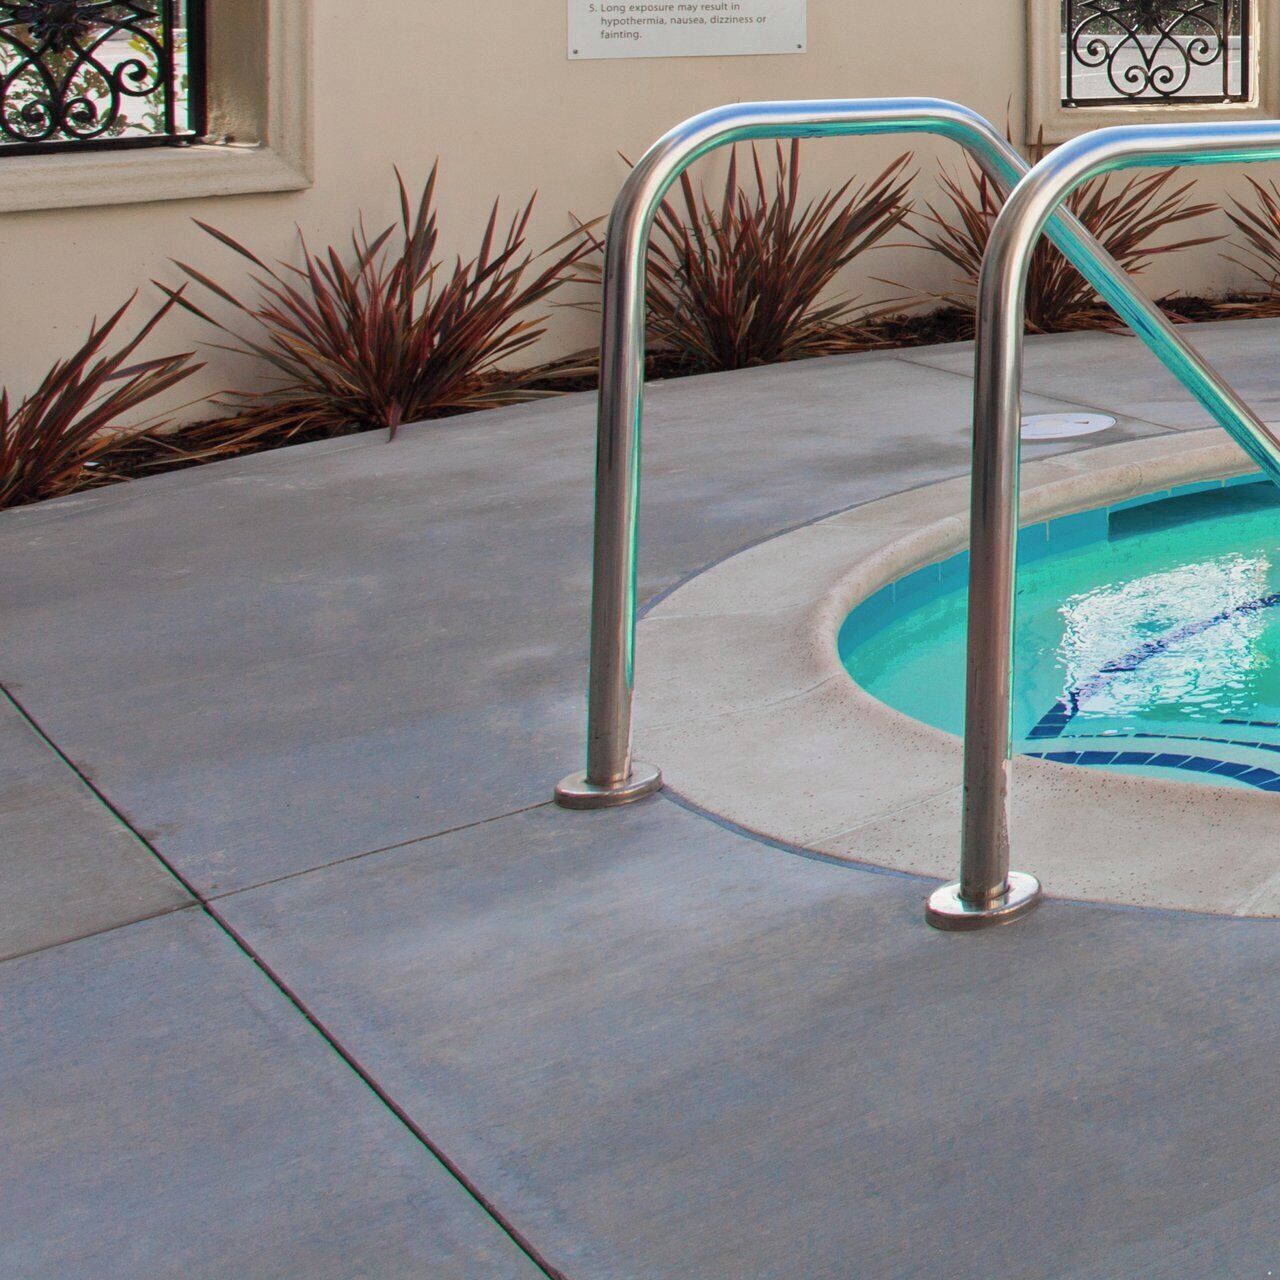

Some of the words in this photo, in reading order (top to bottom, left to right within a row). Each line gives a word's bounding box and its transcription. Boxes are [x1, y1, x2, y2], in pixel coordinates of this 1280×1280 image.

[589, 4, 597, 12] 5.
[601, 4, 625, 14] Long
[629, 4, 674, 13] exposure
[678, 4, 697, 13] may
[701, 3, 727, 12] result
[731, 2, 739, 11] in
[671, 16, 707, 26] nausea,
[710, 15, 753, 24] dizziness
[601, 30, 641, 41] fainting.
